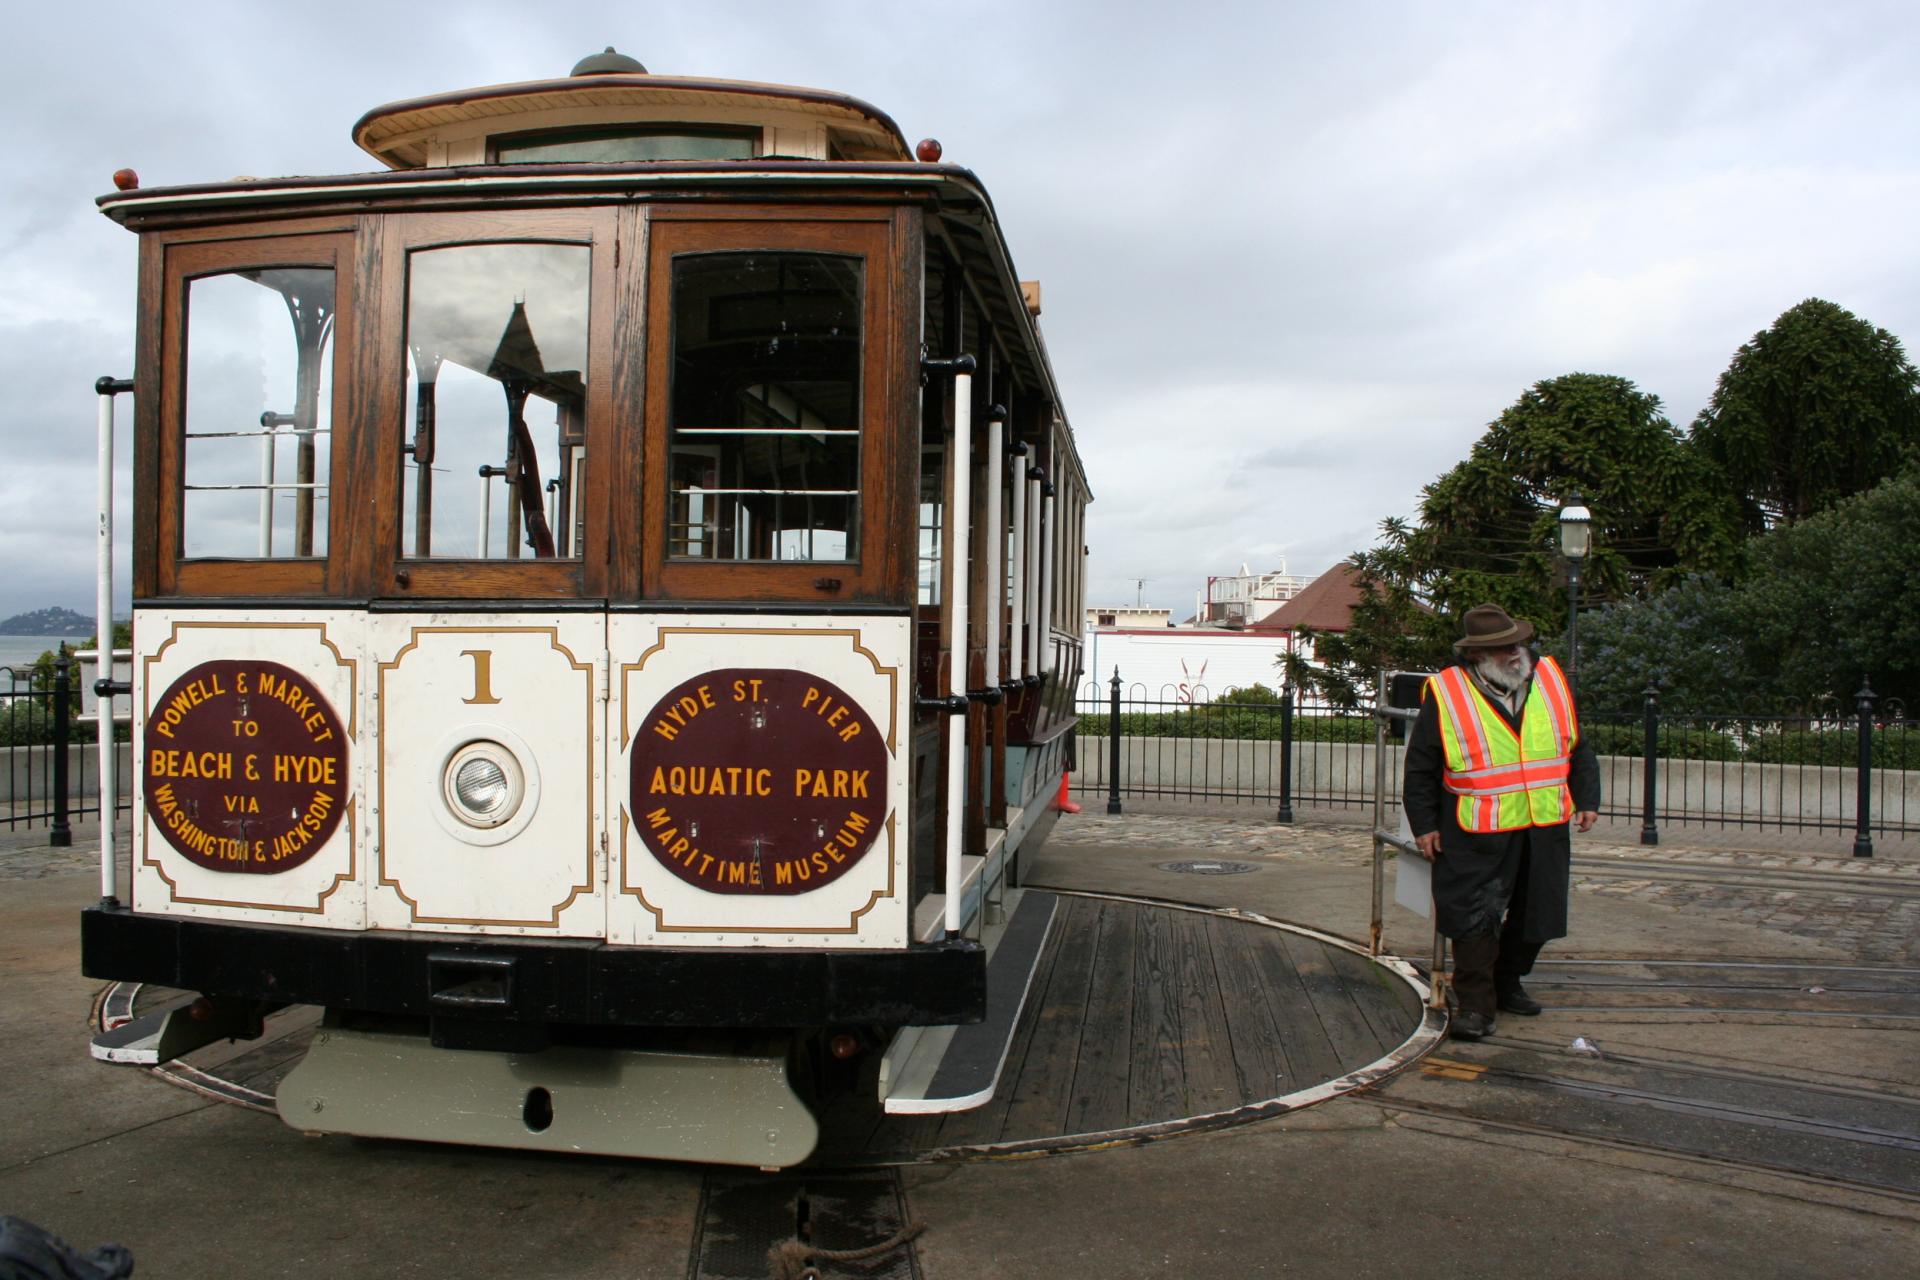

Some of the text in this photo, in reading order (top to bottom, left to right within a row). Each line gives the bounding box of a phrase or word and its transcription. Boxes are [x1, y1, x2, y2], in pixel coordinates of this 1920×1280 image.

[459, 650, 503, 704] 1
[157, 672, 334, 743] POWELL & MARKET
[232, 720, 259, 737] TO
[654, 685, 716, 741] HYDE
[801, 687, 862, 743] PIER
[151, 749, 337, 785] BEACH & HYDE
[650, 766, 870, 798] AQUATIC PARK
[154, 783, 334, 862] WASHINGTON & JACKSON
[224, 795, 260, 814] VIA
[646, 807, 870, 885] MARITIME MUSEUM
